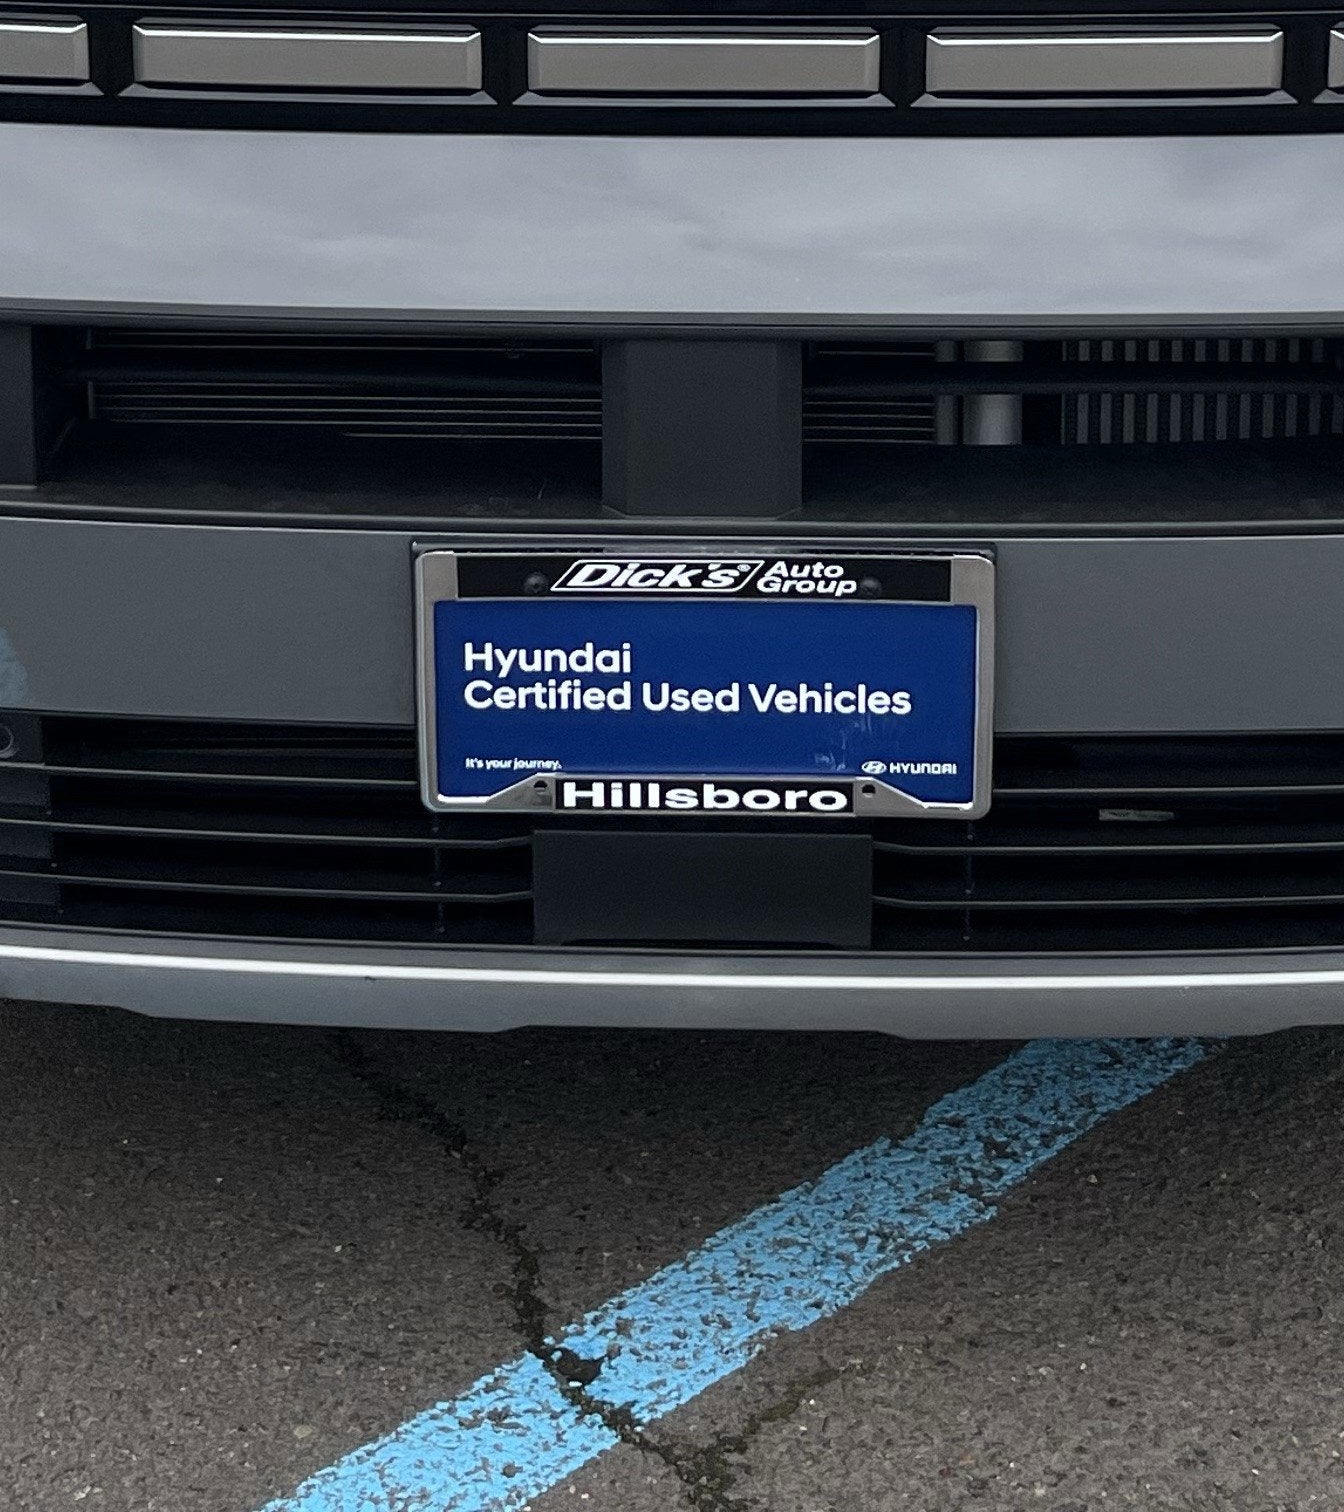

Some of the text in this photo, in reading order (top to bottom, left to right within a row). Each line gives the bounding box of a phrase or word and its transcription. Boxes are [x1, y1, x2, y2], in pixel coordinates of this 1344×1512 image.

[763, 561, 844, 578] Auto
[756, 576, 857, 597] Group
[463, 642, 632, 678] Hyundai
[463, 679, 912, 716] Certified Used Vehicles
[465, 757, 563, 771] It's your journey.
[889, 762, 958, 775] HYUNDAI
[562, 781, 849, 813] Hillsboro
